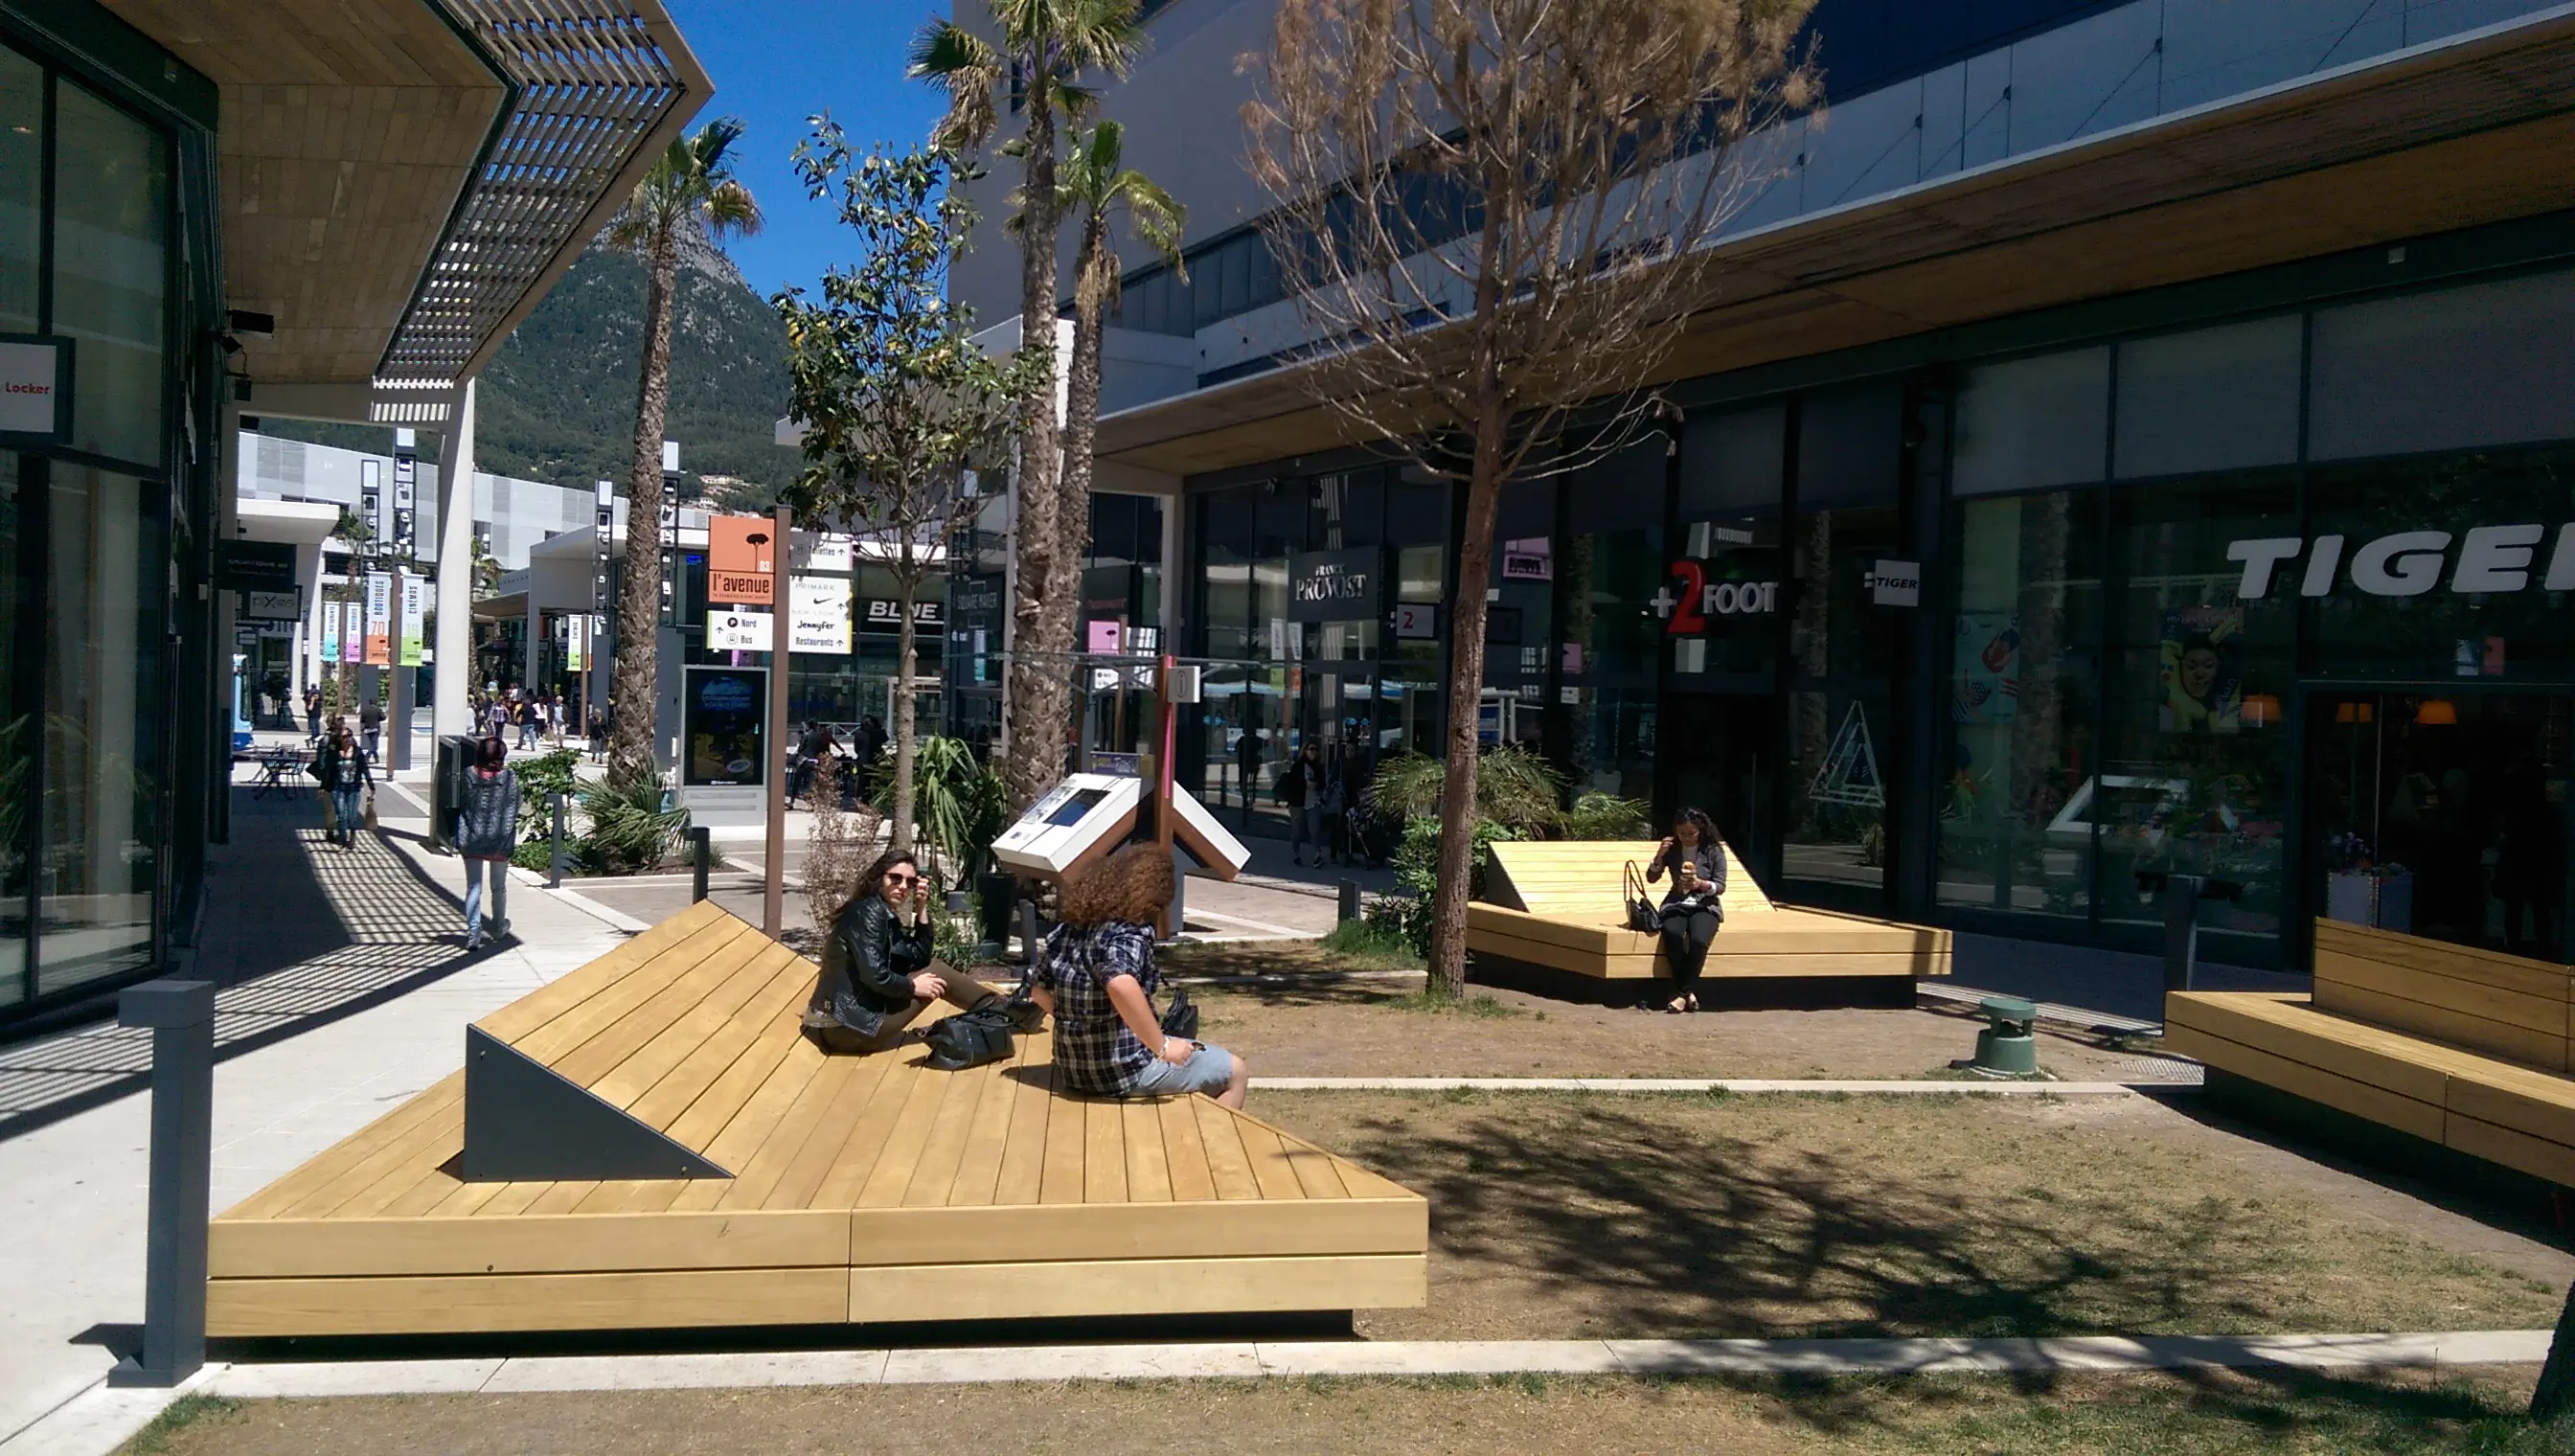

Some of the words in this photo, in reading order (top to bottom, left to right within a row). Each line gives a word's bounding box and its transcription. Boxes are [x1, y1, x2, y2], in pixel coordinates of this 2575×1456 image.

[6, 382, 51, 394] Locker
[713, 573, 770, 594] l'avenue
[795, 582, 836, 592] PRIMARK
[1295, 575, 1368, 601] PROVOST
[1876, 577, 1918, 589] TIGER
[741, 618, 757, 628] Nord
[741, 634, 753, 645] Bus
[795, 636, 834, 648] Restaurants
